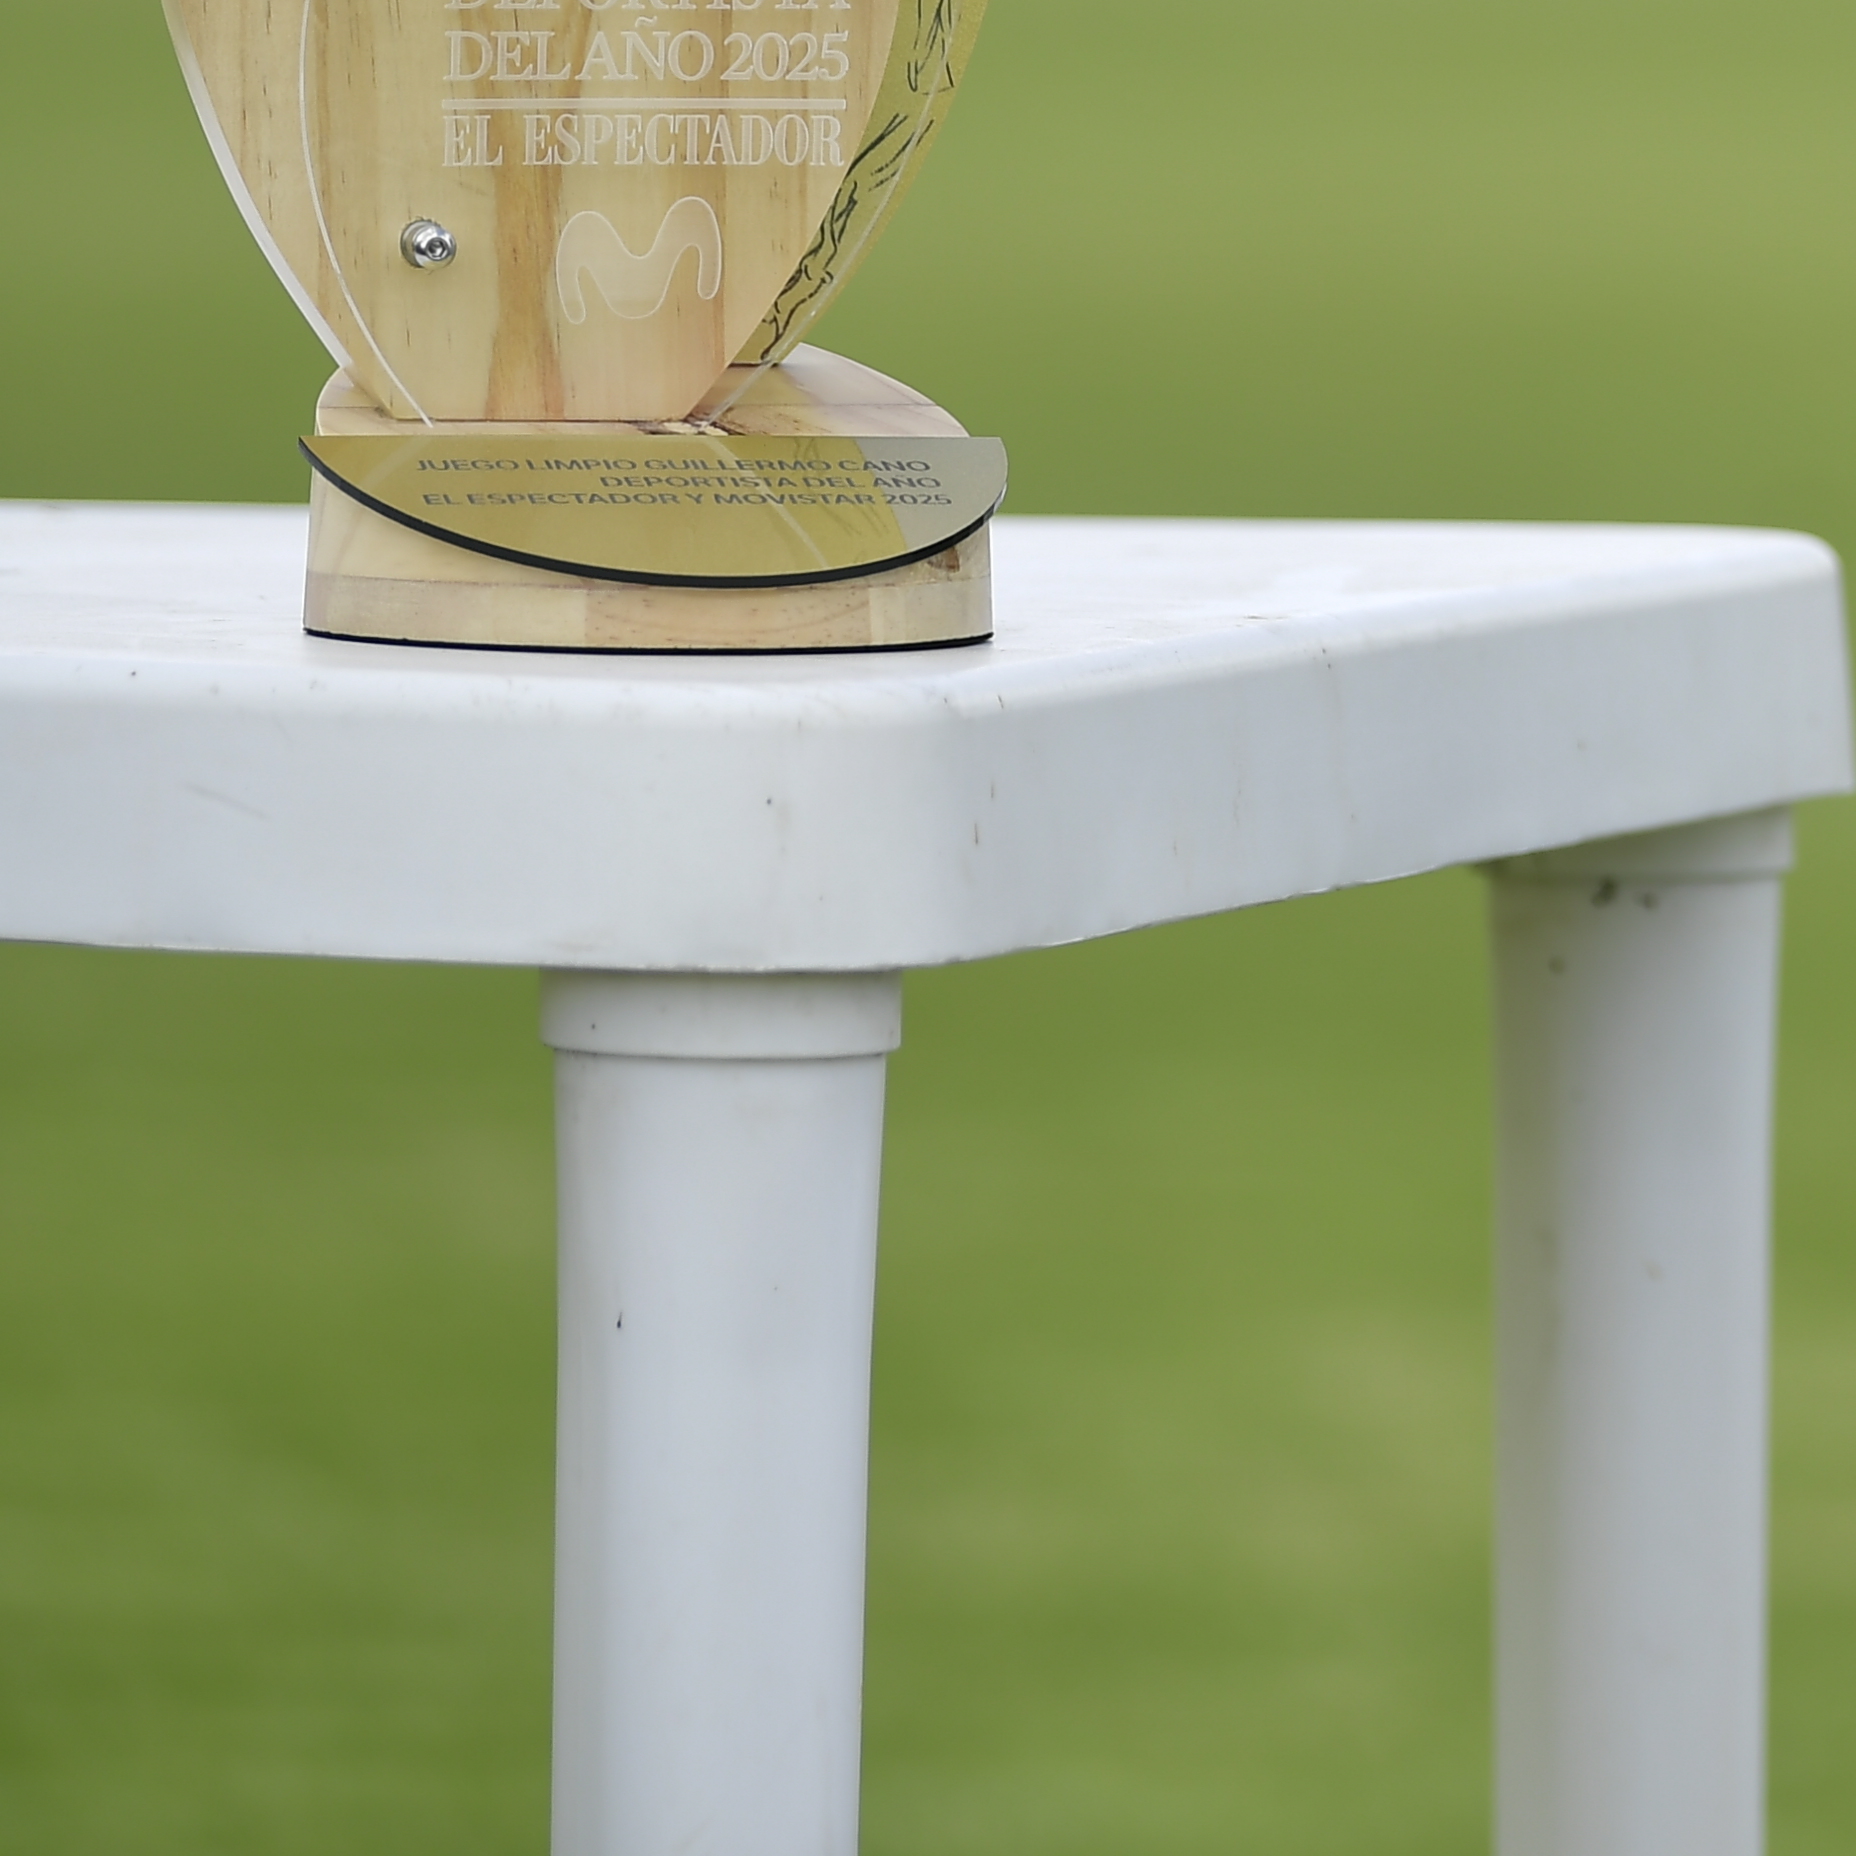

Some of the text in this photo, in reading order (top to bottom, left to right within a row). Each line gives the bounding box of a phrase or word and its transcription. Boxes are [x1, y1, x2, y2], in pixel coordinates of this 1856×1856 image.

[442, 14, 850, 82] DEL AÑO 2025
[441, 113, 846, 168] EL ESPECTADOR
[416, 459, 931, 473] JUEGO LIMPIO GUILLERMO CANO
[599, 473, 942, 489] DEPORTISTA DEL AÑO
[422, 493, 953, 506] EL ESPECTADOR Y MOVISTAR 2025
